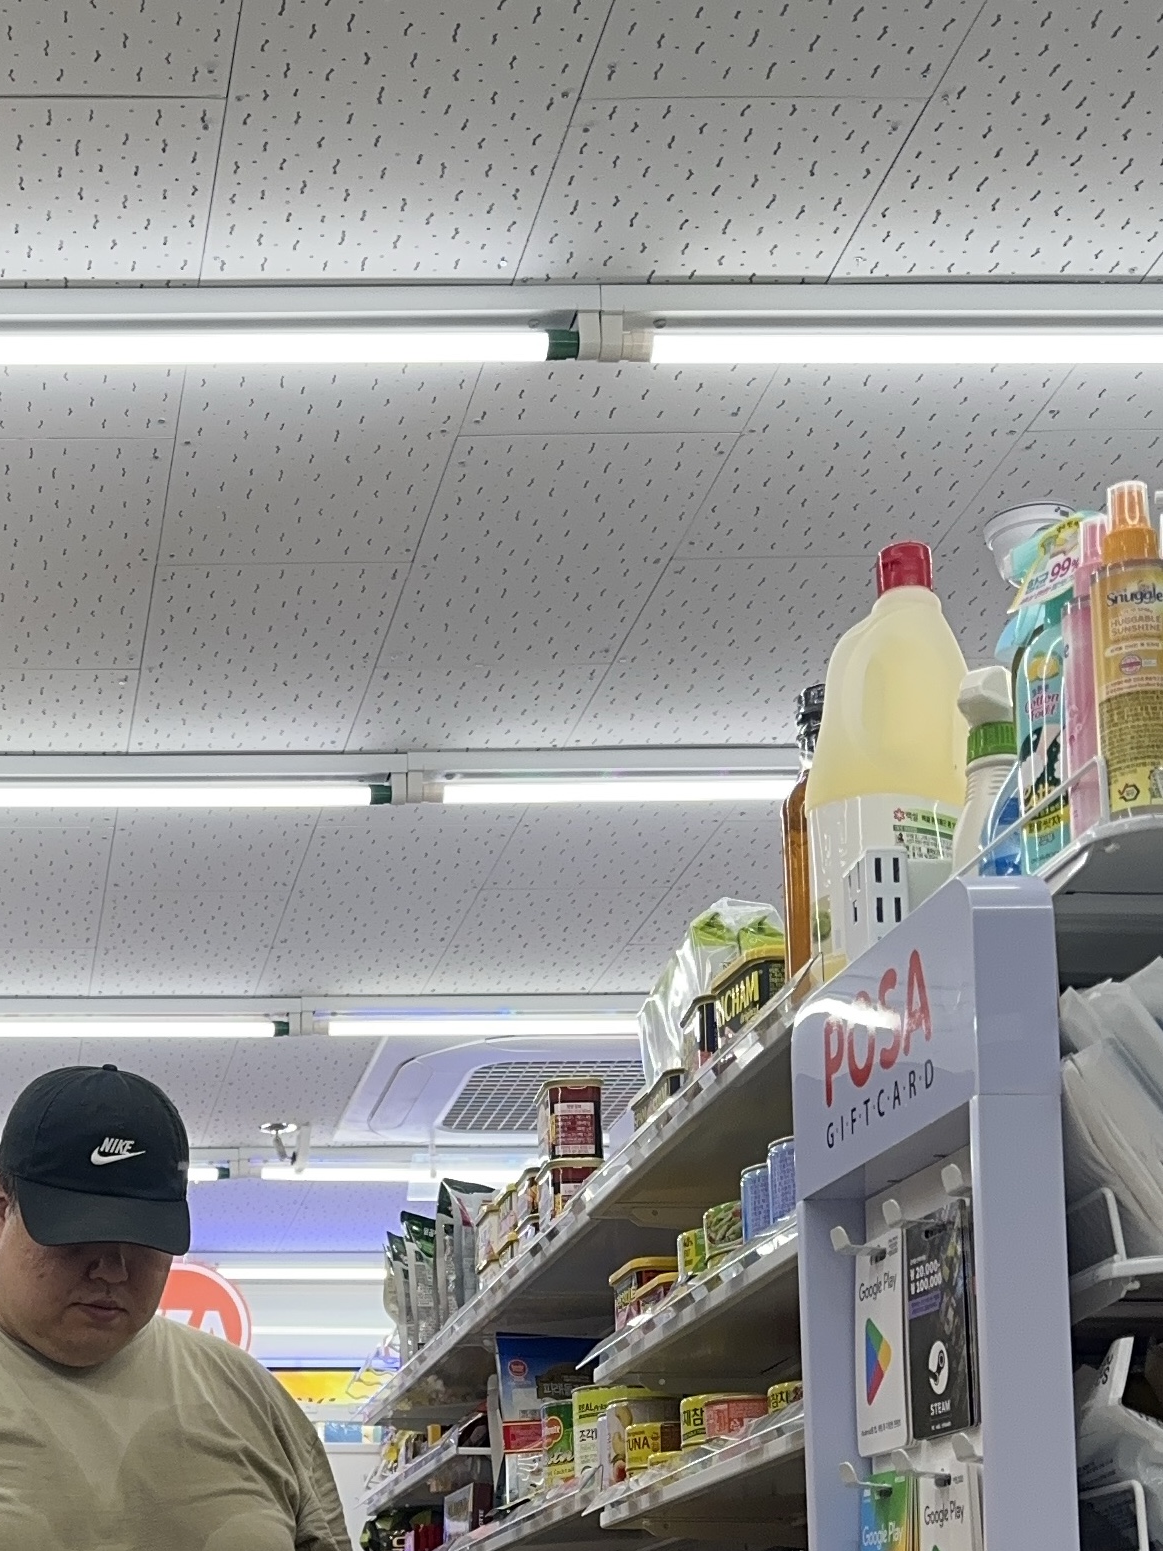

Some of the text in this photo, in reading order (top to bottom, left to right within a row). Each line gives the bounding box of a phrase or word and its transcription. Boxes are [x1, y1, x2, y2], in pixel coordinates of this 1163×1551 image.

[1106, 582, 1163, 608] Snuggle
[1110, 614, 1161, 628] HUGGABLE
[1110, 624, 1162, 637] SUNSHINE
[823, 949, 932, 1108] POSA
[99, 1136, 134, 1154] NIKE
[858, 1270, 898, 1303] Google Play
[929, 1398, 952, 1417] STEAM
[923, 1501, 965, 1529] Google Play
[862, 1520, 904, 1551] Google Play
